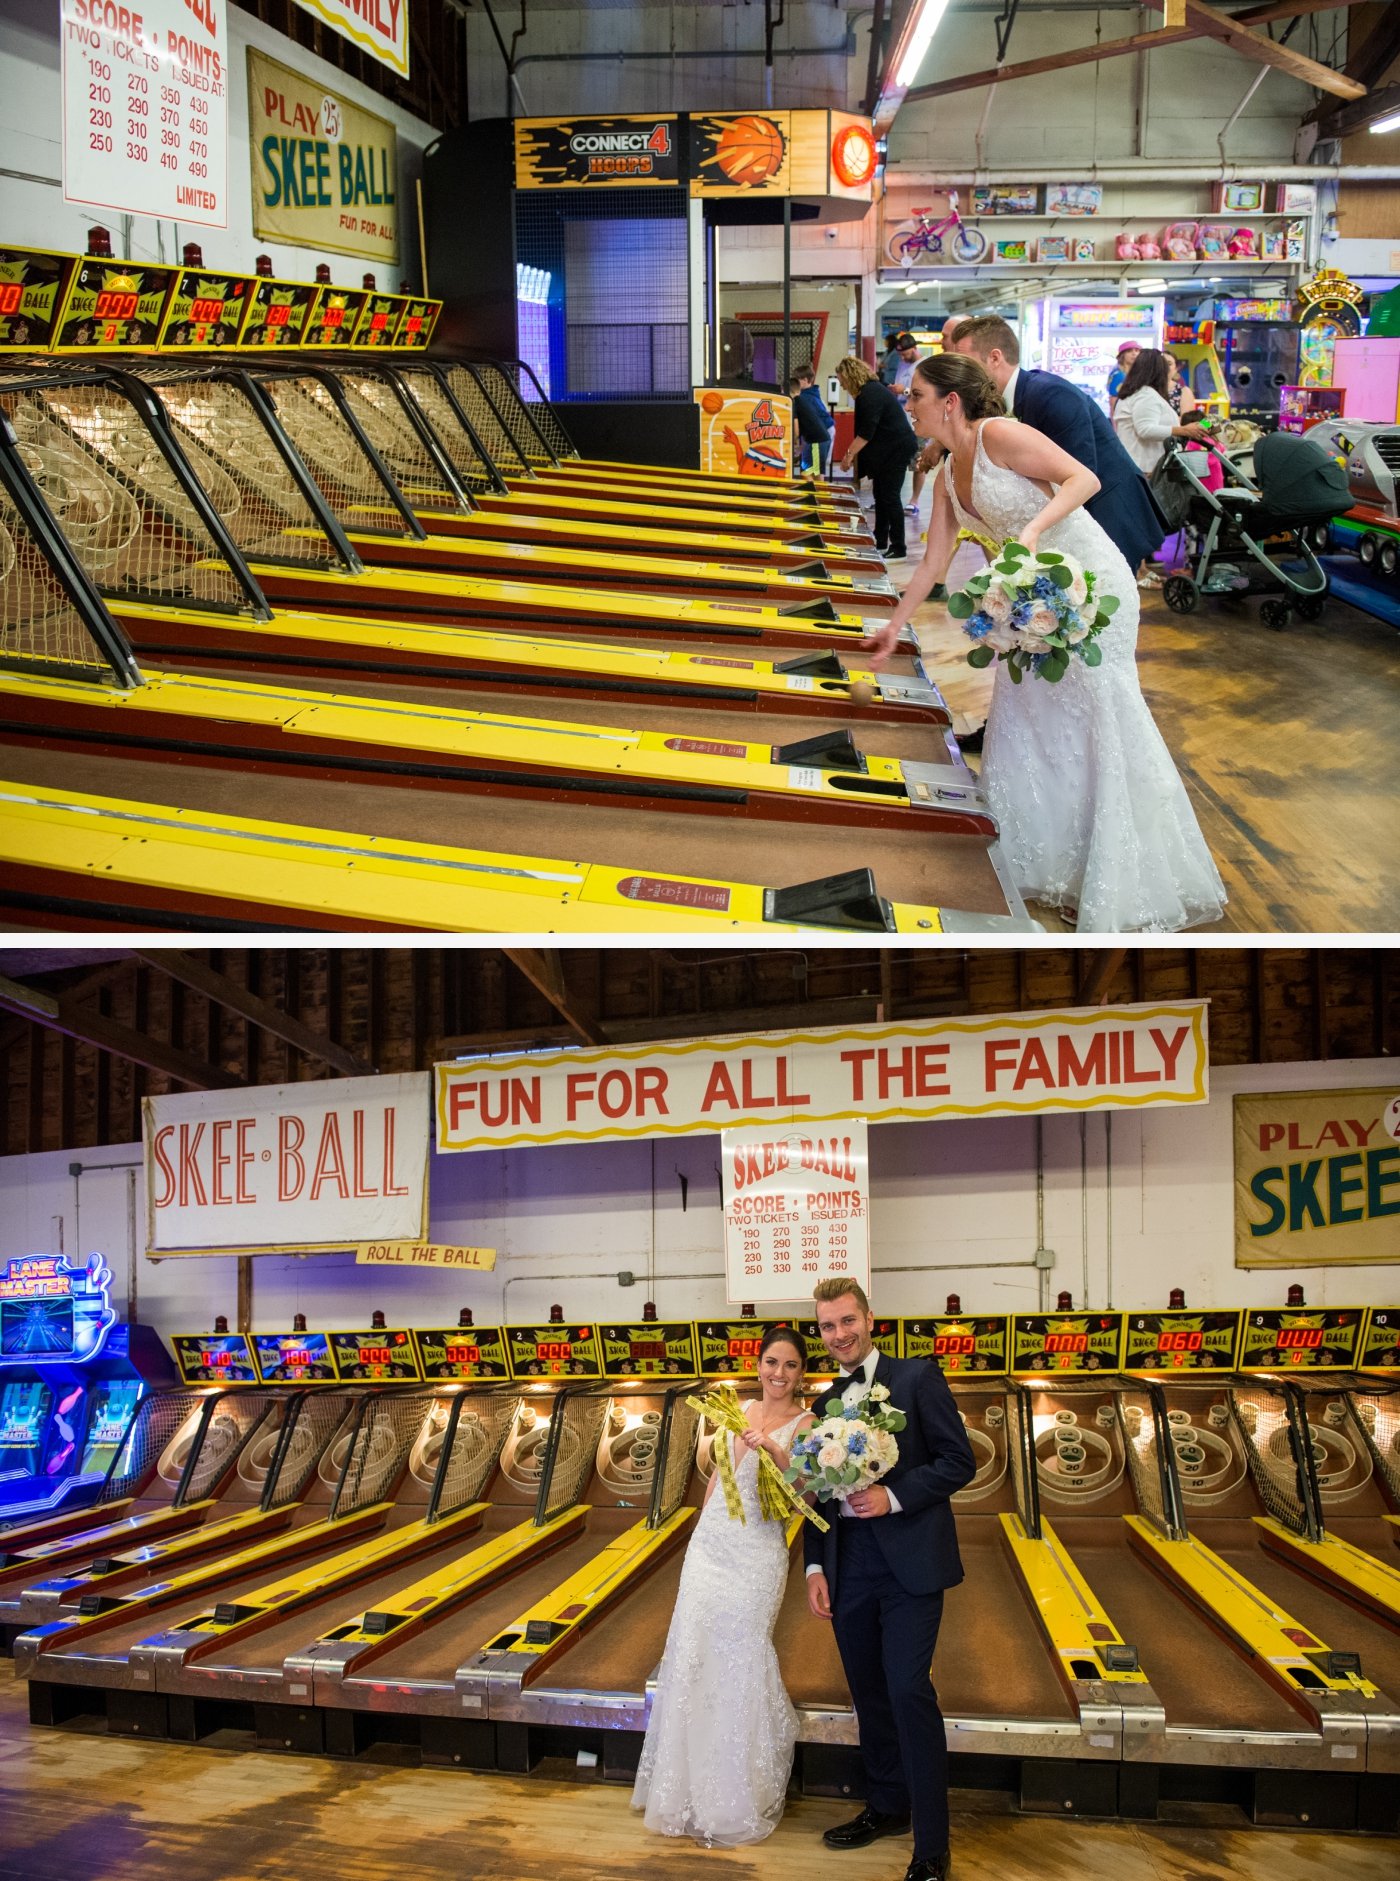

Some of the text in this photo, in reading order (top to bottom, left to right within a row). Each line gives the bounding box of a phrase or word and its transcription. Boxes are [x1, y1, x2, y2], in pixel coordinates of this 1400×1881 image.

[66, 20, 100, 49] TWO
[75, 0, 143, 47] SCORE
[168, 30, 221, 81] POINTS
[88, 59, 208, 115] 190 270 350 430
[89, 83, 208, 136] 210 290 370 450
[264, 87, 319, 136] PLAY
[89, 108, 207, 158] 230 310 390 470
[572, 135, 650, 152] CONNECT
[89, 132, 208, 178] 250 330 410 490
[262, 135, 395, 207] SKEE BALL
[589, 156, 652, 173] HOOPS
[176, 185, 216, 210] LIMITED
[361, 220, 377, 237] FOR
[81, 270, 88, 283] 6
[182, 279, 188, 290] 7
[24, 292, 50, 309] BALL
[70, 297, 95, 311] SKEE
[138, 300, 157, 314] BALL
[223, 305, 239, 318] BALL
[753, 400, 772, 423] 4
[450, 1025, 1191, 1131] FUN FOR ALL THE FAMILY
[1259, 1118, 1380, 1151] PLAY
[733, 1137, 856, 1190] SKEE BALL
[1250, 1146, 1400, 1237] SKEE
[732, 1190, 861, 1215] SCORE POINTS
[727, 1209, 865, 1226] TWO TICKETS ISSUED AT:
[743, 1223, 848, 1238] 190 270 350 430
[744, 1235, 848, 1250] 210 290 370 450
[366, 1246, 480, 1265] ROLL THE BALL
[744, 1249, 847, 1263] 230 310 390 470
[10, 1260, 56, 1279] LANE
[744, 1261, 848, 1275] 250 330 410 490
[0, 1277, 70, 1297] MASTER
[1026, 1321, 1033, 1330] 7
[1138, 1320, 1144, 1329] 8
[1257, 1316, 1263, 1325] 9
[1376, 1315, 1387, 1324] 10
[609, 1329, 616, 1338] 3
[706, 1327, 713, 1335] 4
[809, 1326, 816, 1335] 5
[913, 1324, 920, 1333] 6
[517, 1332, 523, 1341] 2
[1090, 1336, 1113, 1347] BALL
[1132, 1337, 1156, 1348] SKEE
[1159, 1332, 1202, 1351] 060
[1205, 1335, 1228, 1346] BALL
[1251, 1333, 1275, 1344] SKEE
[1326, 1333, 1349, 1343] BALL
[1372, 1333, 1397, 1343] SKEE
[668, 1345, 688, 1355] BALL
[705, 1344, 726, 1352] SKEE
[910, 1340, 932, 1350] SKEE
[978, 1338, 1000, 1349] BALL
[1020, 1339, 1042, 1349] SKEE
[340, 1352, 357, 1360] SKEE
[392, 1351, 409, 1360] BALL
[427, 1350, 445, 1359] SKEE
[482, 1348, 499, 1358] BALL
[516, 1348, 535, 1356] SKEE
[573, 1346, 592, 1355] BALL
[609, 1346, 629, 1355] SKEE
